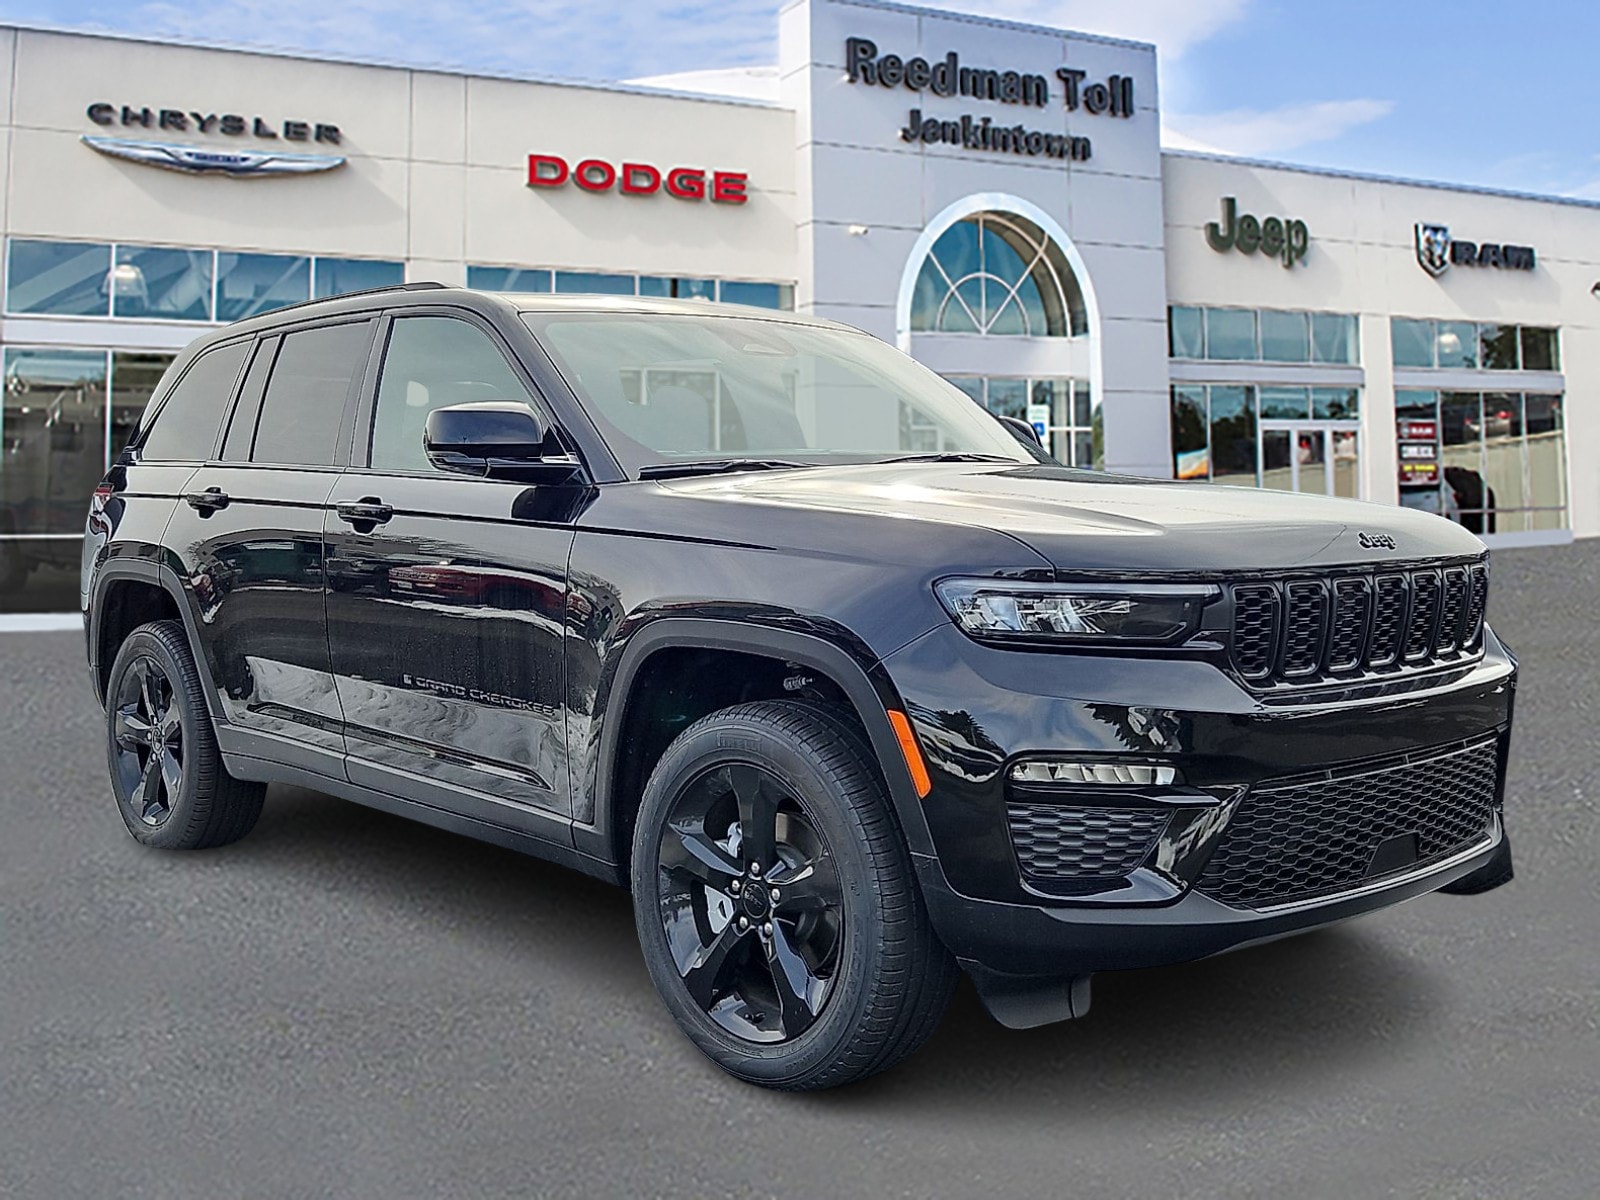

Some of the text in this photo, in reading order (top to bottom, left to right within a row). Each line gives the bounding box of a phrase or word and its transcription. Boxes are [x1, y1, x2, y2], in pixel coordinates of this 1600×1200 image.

[846, 37, 1135, 119] Reedman Toll
[87, 102, 341, 145] CHRYSLER
[901, 109, 1092, 161] Jenkintown
[527, 154, 748, 205] DODGE
[1204, 196, 1308, 270] Jeep
[1450, 240, 1535, 271] RAM
[1358, 531, 1396, 551] Jeep
[415, 677, 555, 716] GRAND CHEROKEE
